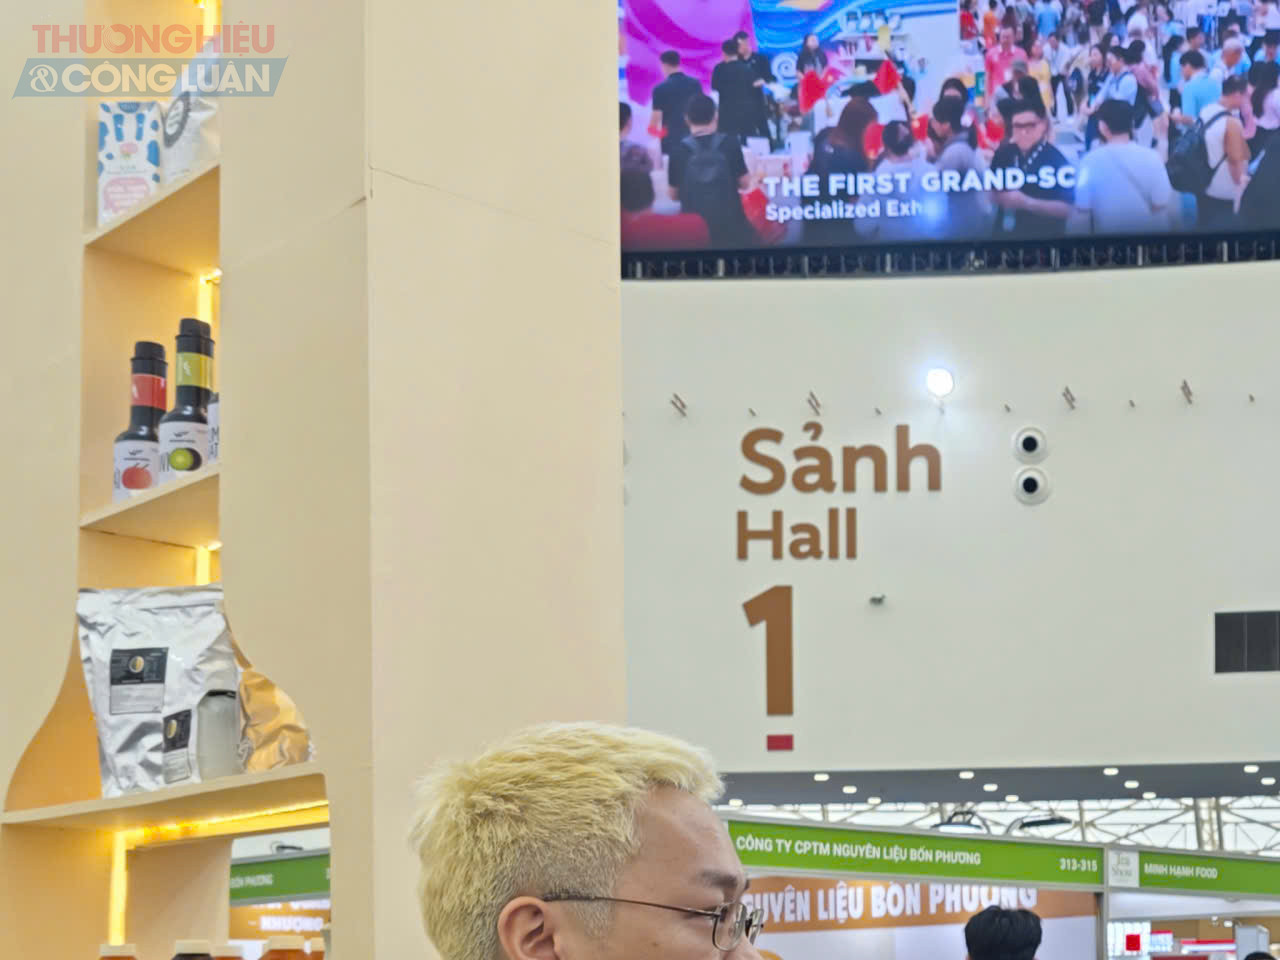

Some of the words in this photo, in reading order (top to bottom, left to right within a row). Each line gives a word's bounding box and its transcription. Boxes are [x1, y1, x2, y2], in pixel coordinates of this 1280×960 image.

[763, 175, 820, 198] THE
[829, 172, 911, 196] FIRST
[765, 199, 881, 223] Specialized
[739, 421, 942, 495] Sảnh
[737, 507, 858, 561] Hall
[742, 585, 794, 717] 1
[736, 834, 773, 852] CÔNG
[775, 839, 793, 854] TY
[794, 840, 831, 857] CPTM
[832, 843, 881, 860] NGUYÊN
[883, 845, 908, 864] LIỆU
[909, 847, 934, 863] BỐN
[935, 849, 981, 866] PHƯƠNG
[1060, 858, 1098, 872] 313-315
[1144, 862, 1168, 875] MINH
[1195, 866, 1218, 879] FOOD
[817, 880, 864, 924] LIỆU
